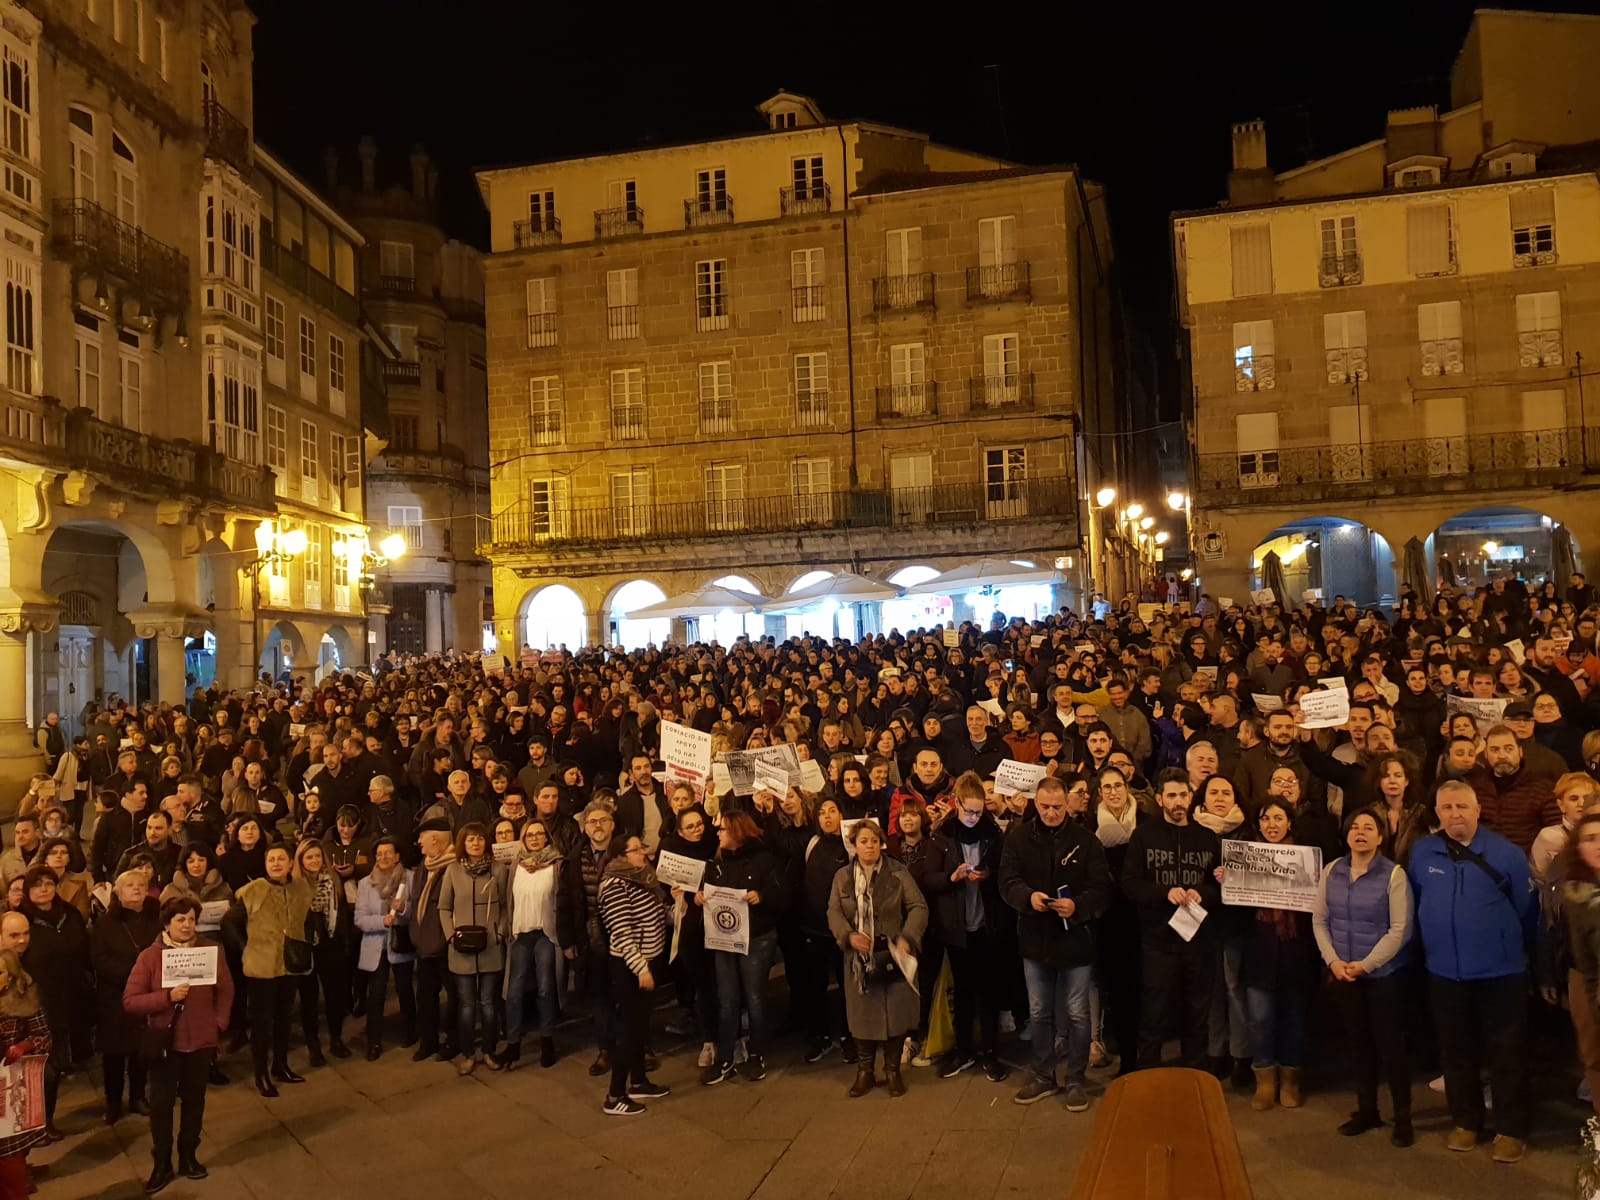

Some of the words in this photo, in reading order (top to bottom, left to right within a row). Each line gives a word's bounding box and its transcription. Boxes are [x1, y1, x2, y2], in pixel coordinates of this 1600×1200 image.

[1146, 848, 1175, 869] PEPE
[1246, 854, 1274, 864] Local
[1271, 864, 1296, 875] Vida
